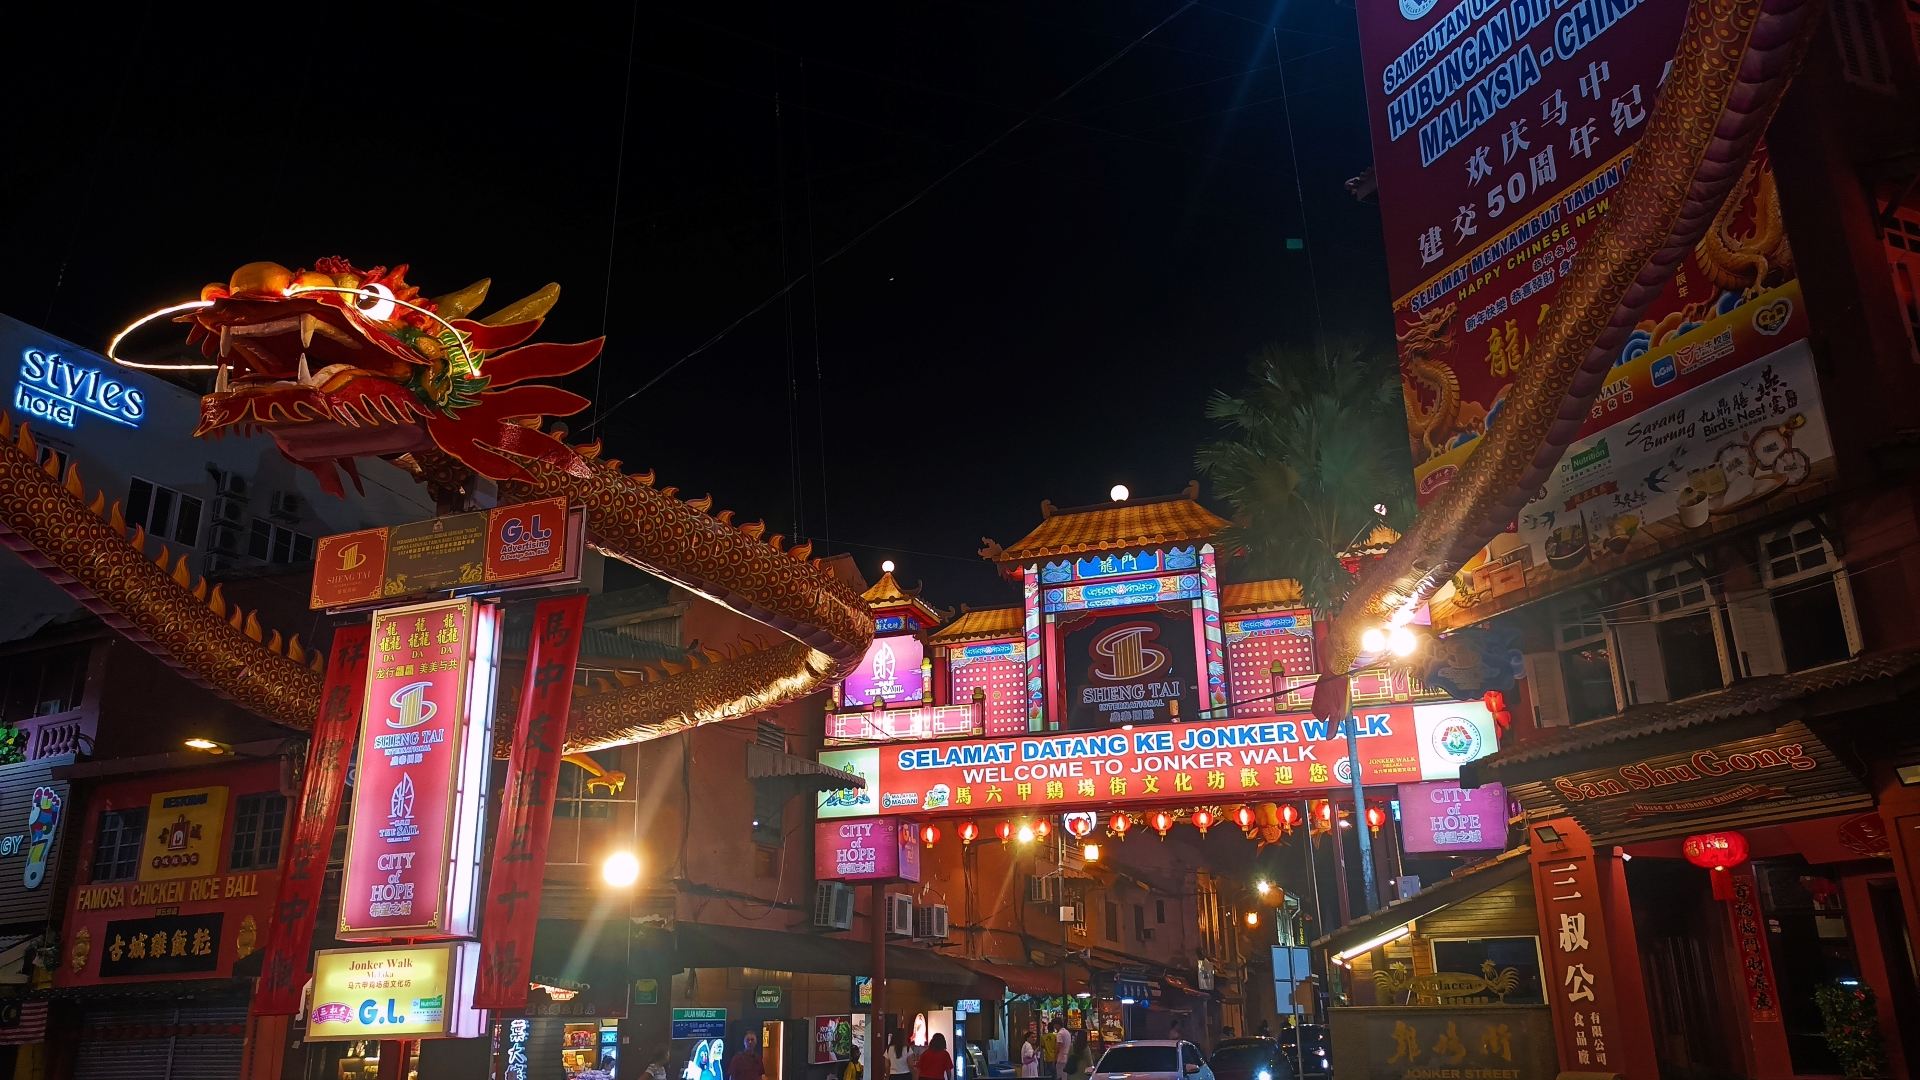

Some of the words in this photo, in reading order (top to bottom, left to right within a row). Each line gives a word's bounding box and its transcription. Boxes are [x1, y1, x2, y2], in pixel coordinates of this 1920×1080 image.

[1383, 4, 1472, 95] SAMBUTAN
[1388, 7, 1513, 141] HUBUNGAN
[1419, 44, 1541, 168] MALAYSIA
[1411, 265, 1469, 313] SELAMAT
[1471, 204, 1561, 275] MENYAMBUT
[1563, 166, 1620, 215] TAHUN
[1458, 265, 1502, 302] HAPPY
[1507, 225, 1571, 270] CHINESE
[1575, 197, 1611, 228] NEW
[24, 349, 145, 420] styles
[16, 384, 79, 428] hotel
[1625, 408, 1686, 447] Sarang
[1703, 415, 1735, 438] Bird's
[1737, 403, 1766, 423] Nest
[1639, 422, 1696, 452] Burung
[1573, 449, 1607, 467] Nutrition
[500, 513, 553, 544] G.L.
[500, 539, 551, 555] Advertising
[1099, 553, 1138, 574] 龍門
[383, 653, 395, 663] DA
[412, 650, 424, 659] DA
[440, 646, 453, 655] DA
[1083, 685, 1145, 704] SHENG
[1147, 681, 1181, 698] TAI
[421, 728, 445, 744] TAI
[898, 743, 1016, 770] SELAMAT
[1022, 735, 1128, 762] DATANG
[1136, 730, 1174, 754] KE
[1180, 722, 1297, 750] JONKER
[963, 760, 1084, 784] WELCOME
[1090, 759, 1124, 777] TO
[1130, 751, 1233, 774] JONKER
[1246, 745, 1318, 766] WALK
[1554, 775, 1630, 802] San
[1618, 761, 1701, 791] Shu
[1691, 743, 1817, 777] Gong
[1430, 788, 1473, 803] CITY
[1636, 802, 1664, 812] House
[1665, 803, 1675, 811] of
[1676, 797, 1713, 812] Authentic
[1447, 803, 1462, 815] of
[839, 823, 875, 839] CITY
[1430, 815, 1481, 831] HOPE
[836, 847, 877, 863] HOPE
[850, 837, 863, 849] of
[377, 852, 416, 871] CITY
[388, 870, 403, 884] of
[77, 886, 126, 911] FAMOSA
[130, 879, 186, 906] CHICKEN
[189, 877, 221, 902] RICE
[225, 874, 258, 899] BALL
[369, 883, 415, 902] HOPE
[1549, 863, 1595, 1003] 三叔公
[348, 959, 384, 972] Jonker
[387, 957, 413, 969] Walk
[358, 998, 405, 1025] G.L.
[1590, 1011, 1607, 1066] 有限公司
[1407, 1068, 1460, 1080] JONKER
[1465, 1068, 1521, 1080] STREET
